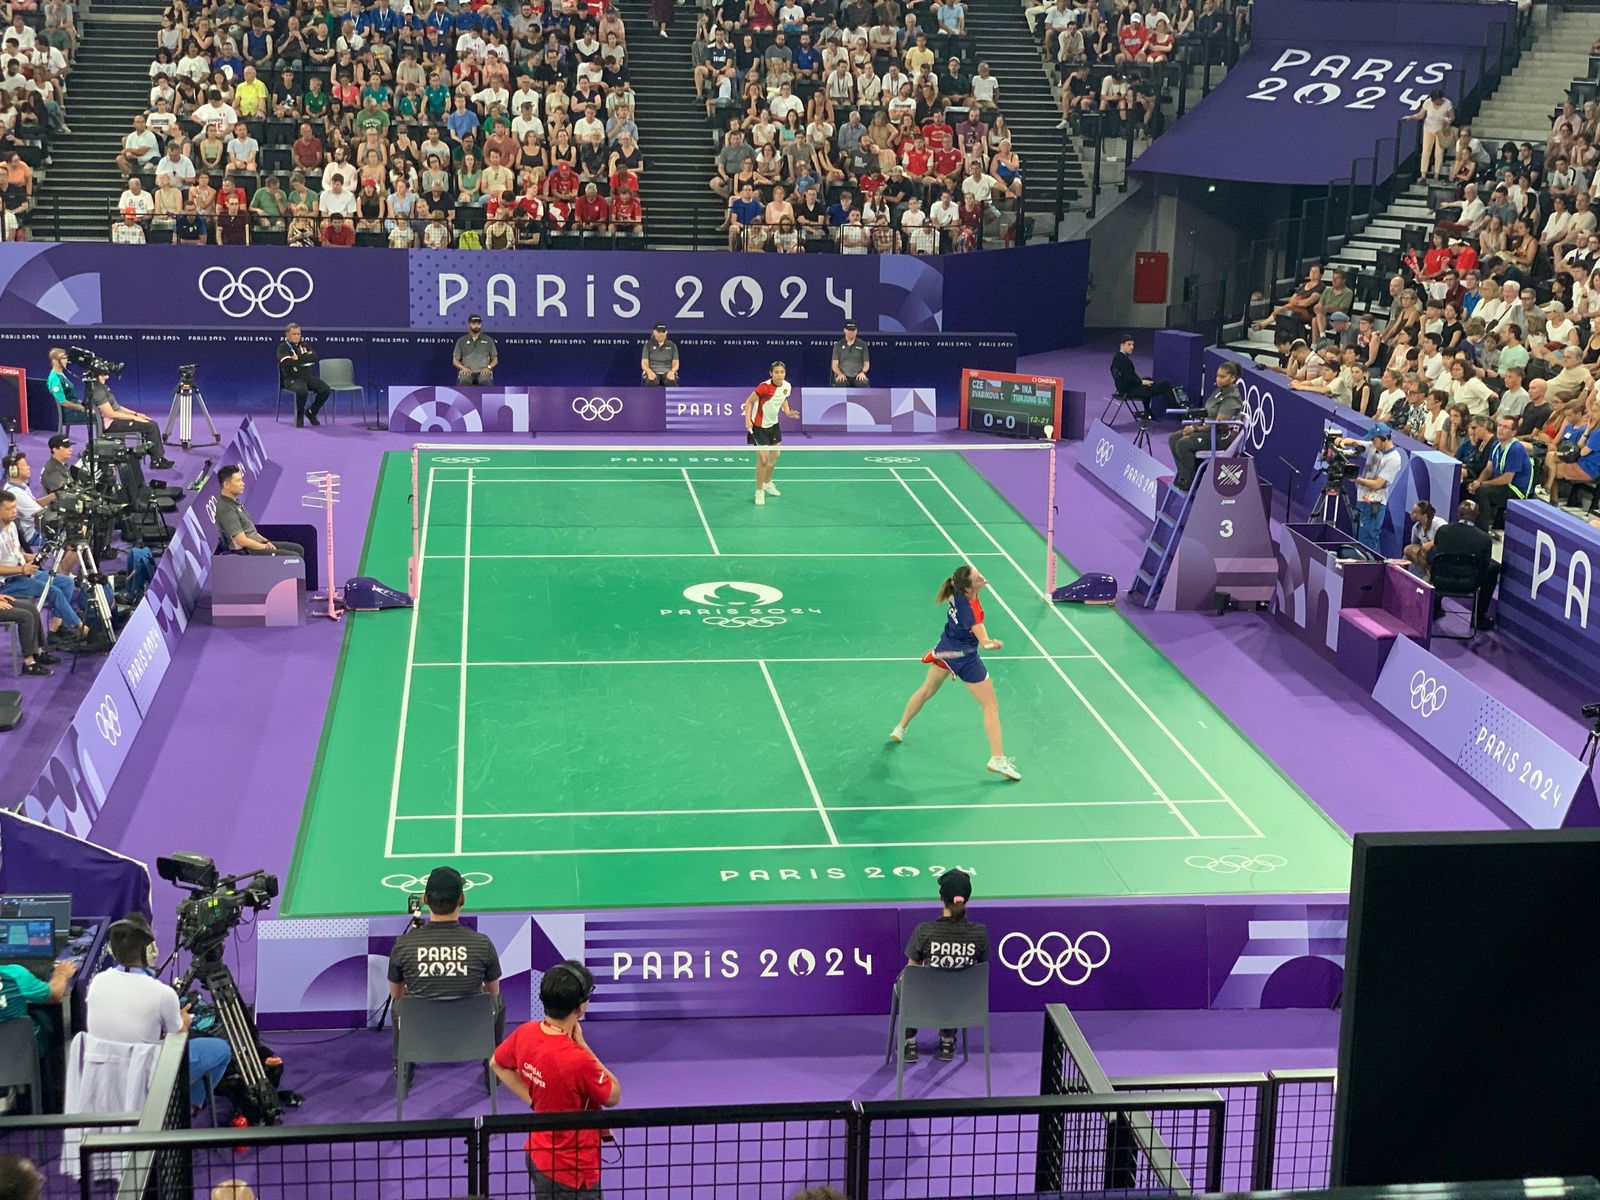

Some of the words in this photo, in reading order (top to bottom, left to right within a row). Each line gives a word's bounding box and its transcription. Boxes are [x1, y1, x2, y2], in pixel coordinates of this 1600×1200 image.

[1246, 77, 1429, 111] 2024
[675, 275, 852, 319] 2024
[972, 380, 984, 389] CZE
[1021, 384, 1033, 394] INA
[983, 413, 993, 427] 0
[1005, 415, 1016, 429] 0
[1142, 475, 1158, 499] 202
[1220, 520, 1234, 537] 3
[750, 607, 822, 615] 2024
[1519, 761, 1561, 808] 2024
[864, 865, 978, 878] 2024
[417, 962, 468, 977] 2024
[759, 948, 872, 978] 2024
